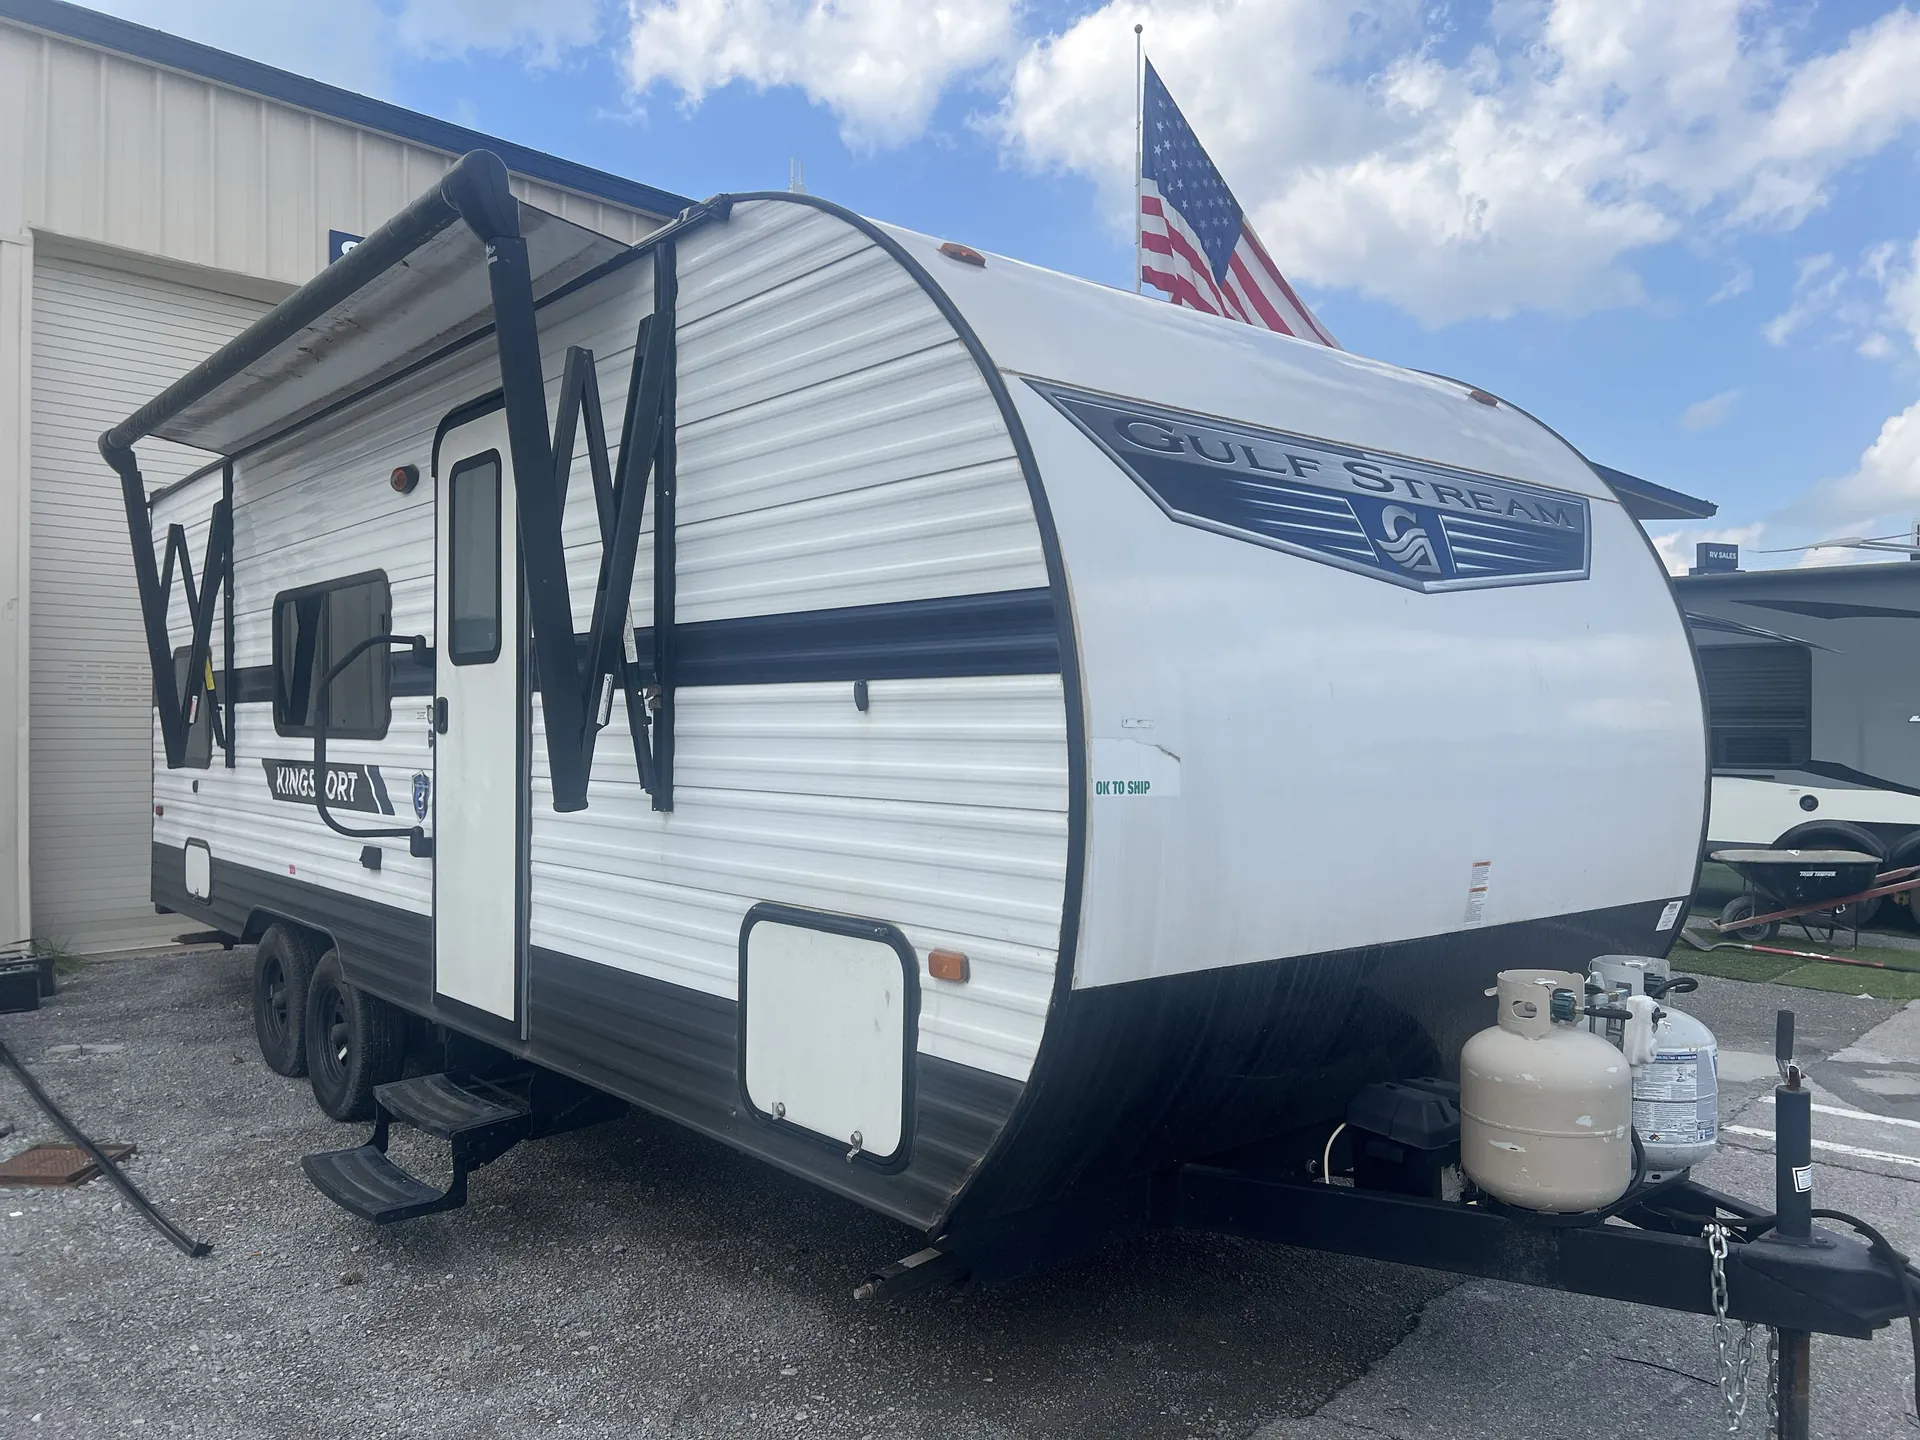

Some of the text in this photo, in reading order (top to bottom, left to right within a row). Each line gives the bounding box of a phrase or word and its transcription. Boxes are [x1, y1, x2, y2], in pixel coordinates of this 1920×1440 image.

[1113, 417, 1575, 529] GULF STREAM
[1709, 551, 1737, 560] RV SALES
[276, 766, 359, 802] KINGSORT
[1095, 781, 1151, 795] OK TO SHIP
